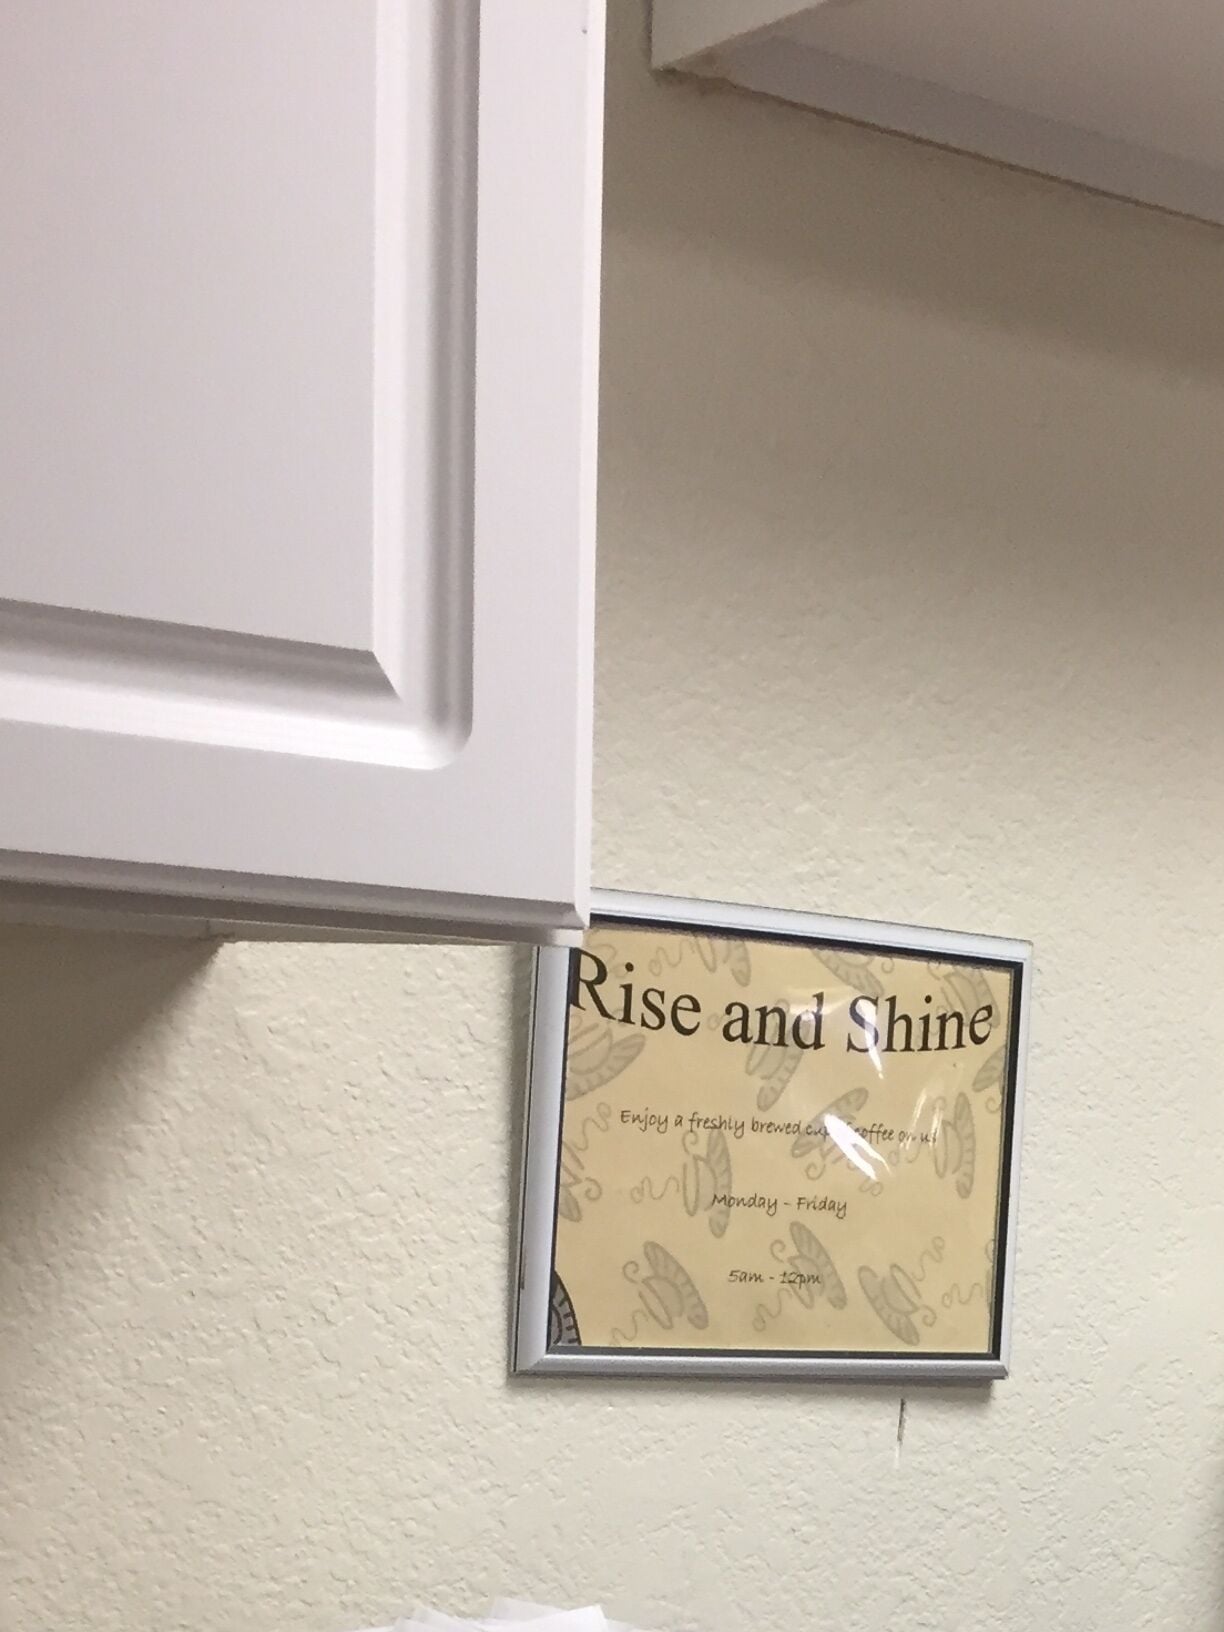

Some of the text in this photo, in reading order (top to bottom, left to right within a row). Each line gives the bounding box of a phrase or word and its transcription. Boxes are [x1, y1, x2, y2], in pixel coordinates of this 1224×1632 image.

[569, 948, 993, 1054] Rise and Shine
[620, 1107, 668, 1132] Enjoy
[674, 1114, 683, 1127] a
[688, 1111, 745, 1139] freshly
[751, 1115, 802, 1136] brewed
[712, 1193, 777, 1217] Monday
[796, 1195, 847, 1220] Friday
[728, 1269, 764, 1283] 5am
[779, 1271, 822, 1289] 12pm
